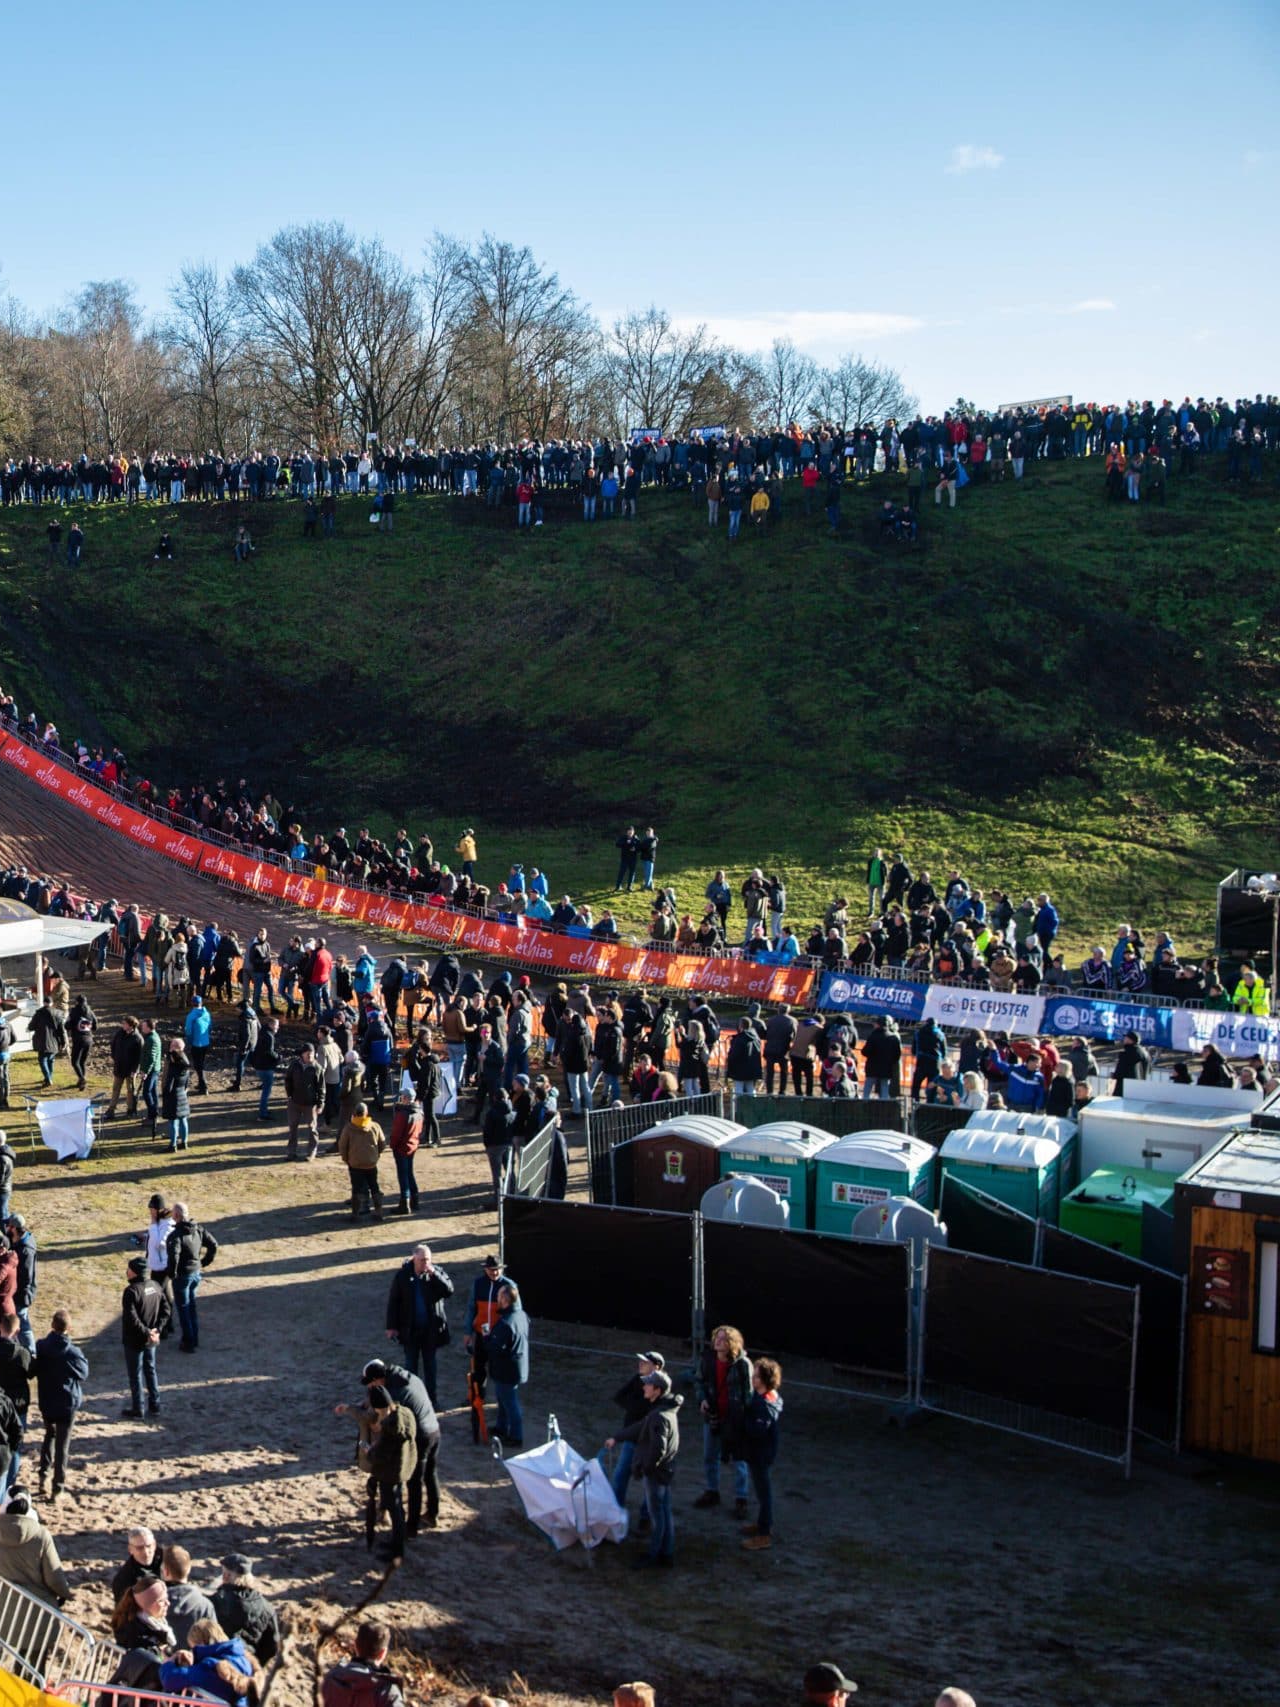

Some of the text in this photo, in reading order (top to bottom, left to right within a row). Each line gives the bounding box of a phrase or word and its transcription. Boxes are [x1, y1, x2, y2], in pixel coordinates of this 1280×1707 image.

[5, 744, 29, 768] ethias
[36, 764, 60, 789] ethias
[68, 784, 93, 808] ethias
[97, 803, 122, 826] ethias
[130, 819, 157, 844] ethias
[165, 835, 195, 861] ethias
[368, 901, 402, 925] ethias
[414, 911, 450, 937] ethias
[463, 922, 501, 949] ethias
[515, 932, 553, 960] ethias
[570, 943, 610, 971] ethias
[684, 958, 730, 987] ethias
[748, 967, 797, 997] ethias
[851, 983, 866, 998] DE
[867, 986, 914, 1004] CEUSTER
[961, 998, 1030, 1017] DE CEUSTER
[1080, 1008, 1097, 1025] DE
[1218, 1024, 1235, 1039] DE
